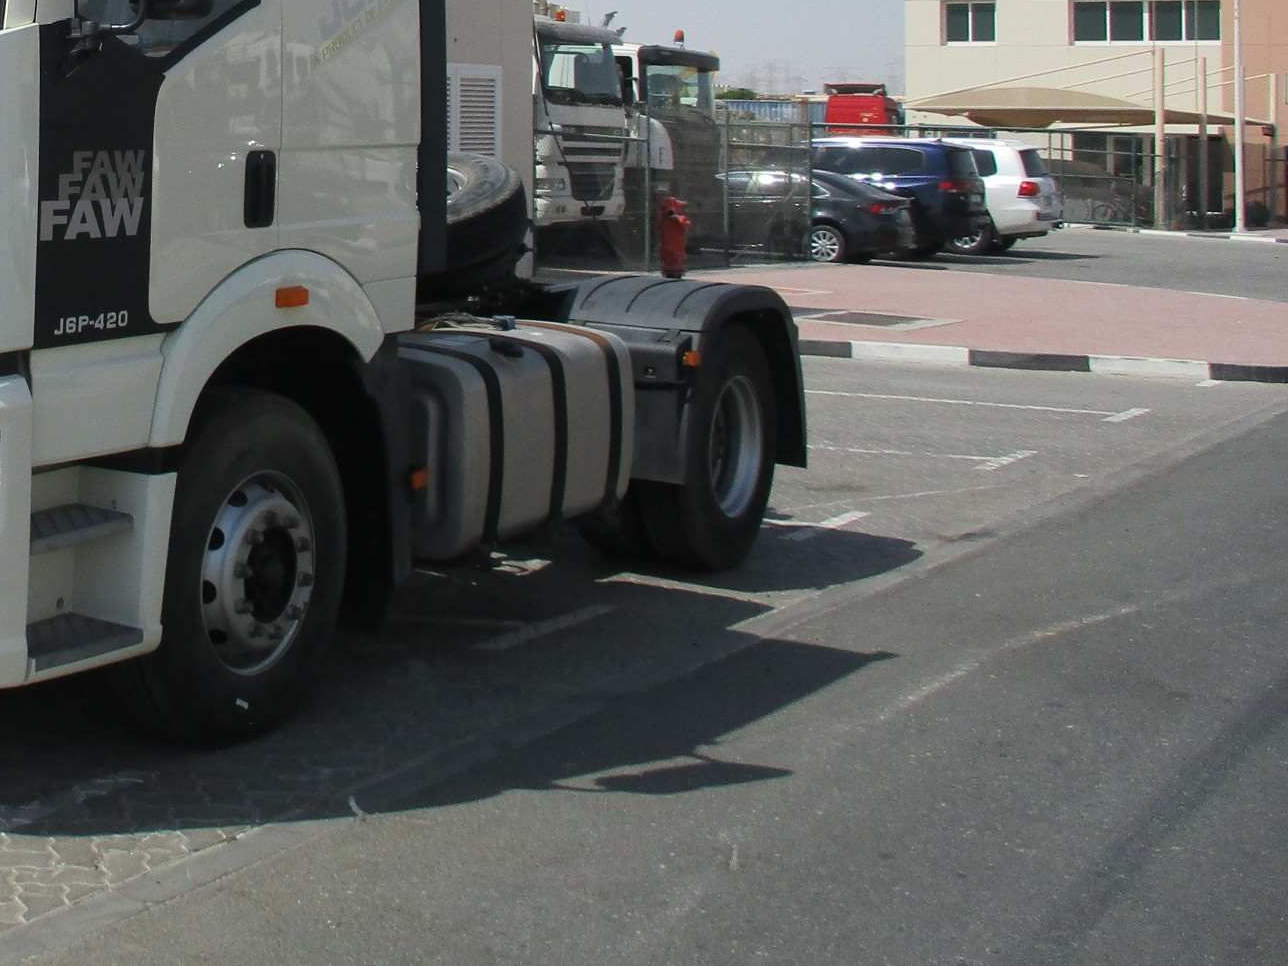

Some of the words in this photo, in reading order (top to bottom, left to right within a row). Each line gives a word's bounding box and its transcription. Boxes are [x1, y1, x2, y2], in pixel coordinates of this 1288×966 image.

[73, 149, 146, 181] FAW
[58, 171, 144, 204] FAW
[40, 197, 144, 241] FAW
[53, 310, 129, 335] J6P-420
